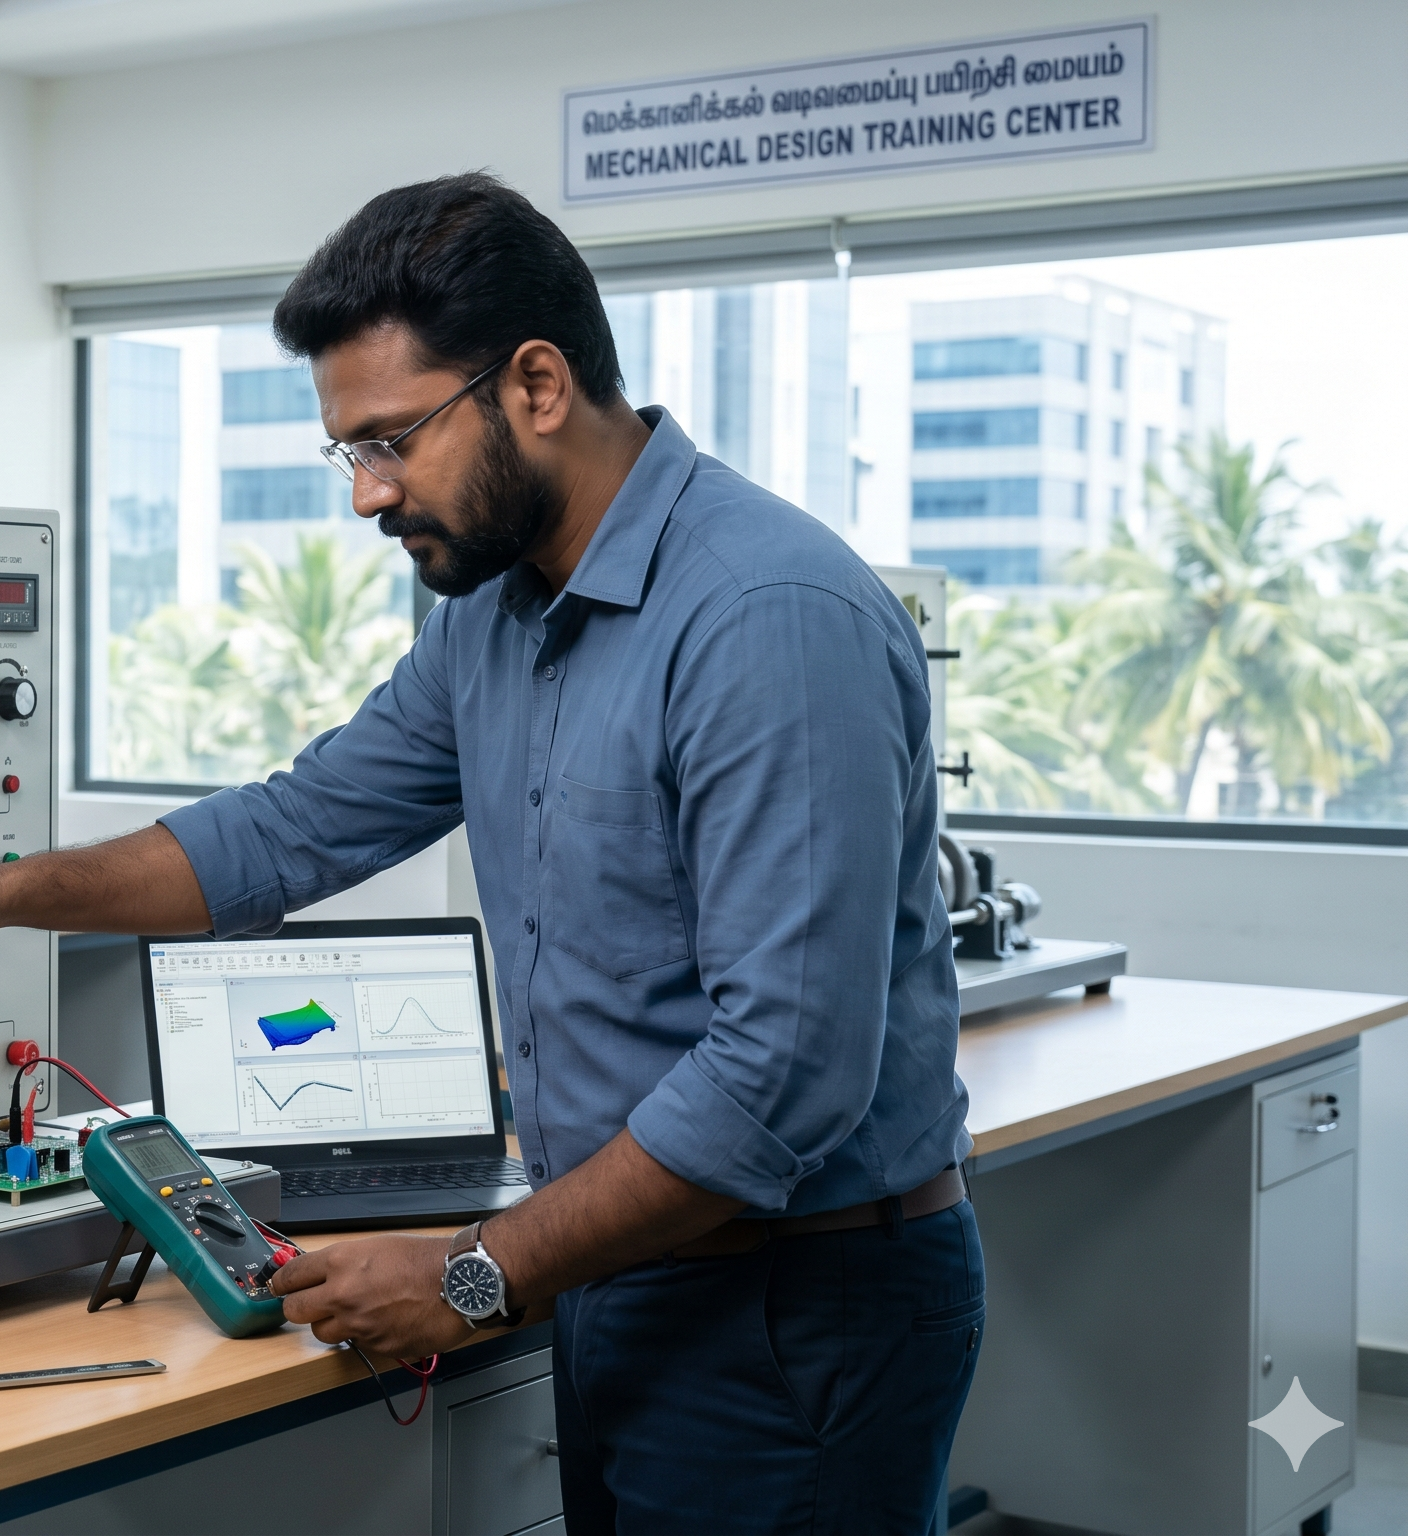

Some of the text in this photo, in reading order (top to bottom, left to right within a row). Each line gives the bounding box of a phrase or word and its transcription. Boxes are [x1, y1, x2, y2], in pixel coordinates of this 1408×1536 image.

[582, 42, 1124, 136] மெக்கானிக்கல் வடிவமைப்பு பயிற்சி மையம்
[585, 96, 1121, 181] MECHANICAL DESIGN TRAINING CENTER
